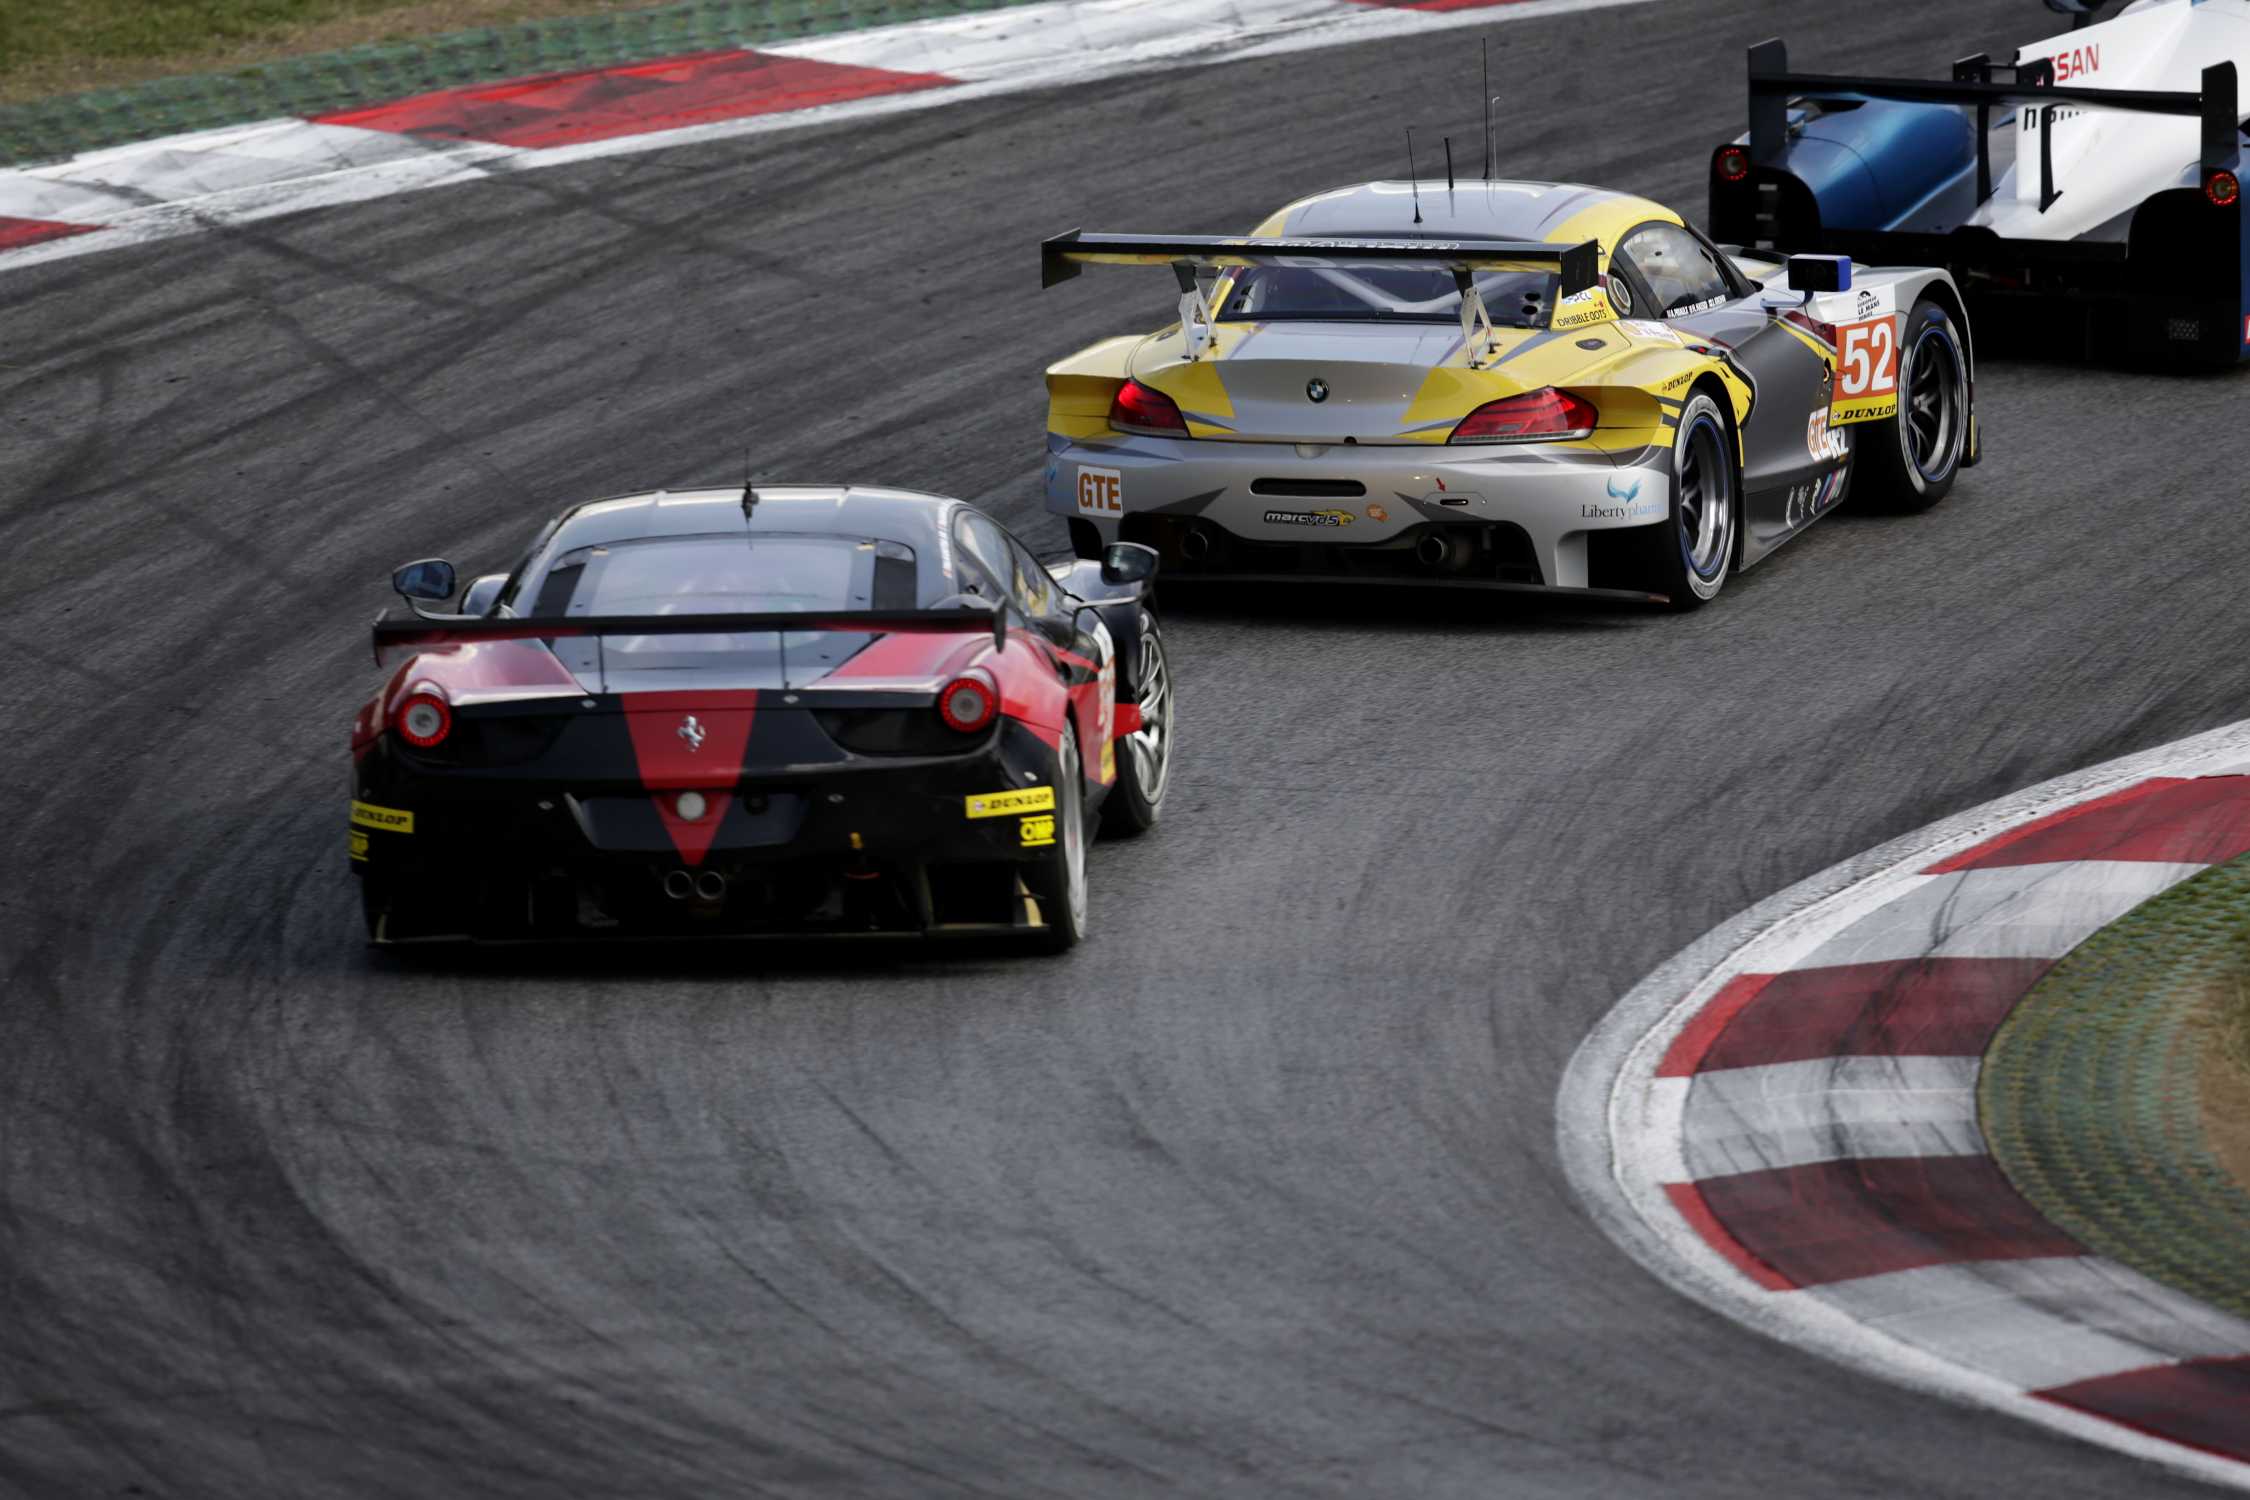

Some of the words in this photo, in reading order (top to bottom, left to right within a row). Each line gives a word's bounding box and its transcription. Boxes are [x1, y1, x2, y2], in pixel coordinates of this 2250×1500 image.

[1558, 312, 1590, 327] DRIBBLE
[1842, 322, 1894, 395] 52
[1667, 371, 1693, 391] DUNLOP
[1843, 403, 1896, 420] DUNLOP
[1080, 472, 1121, 511] GTE
